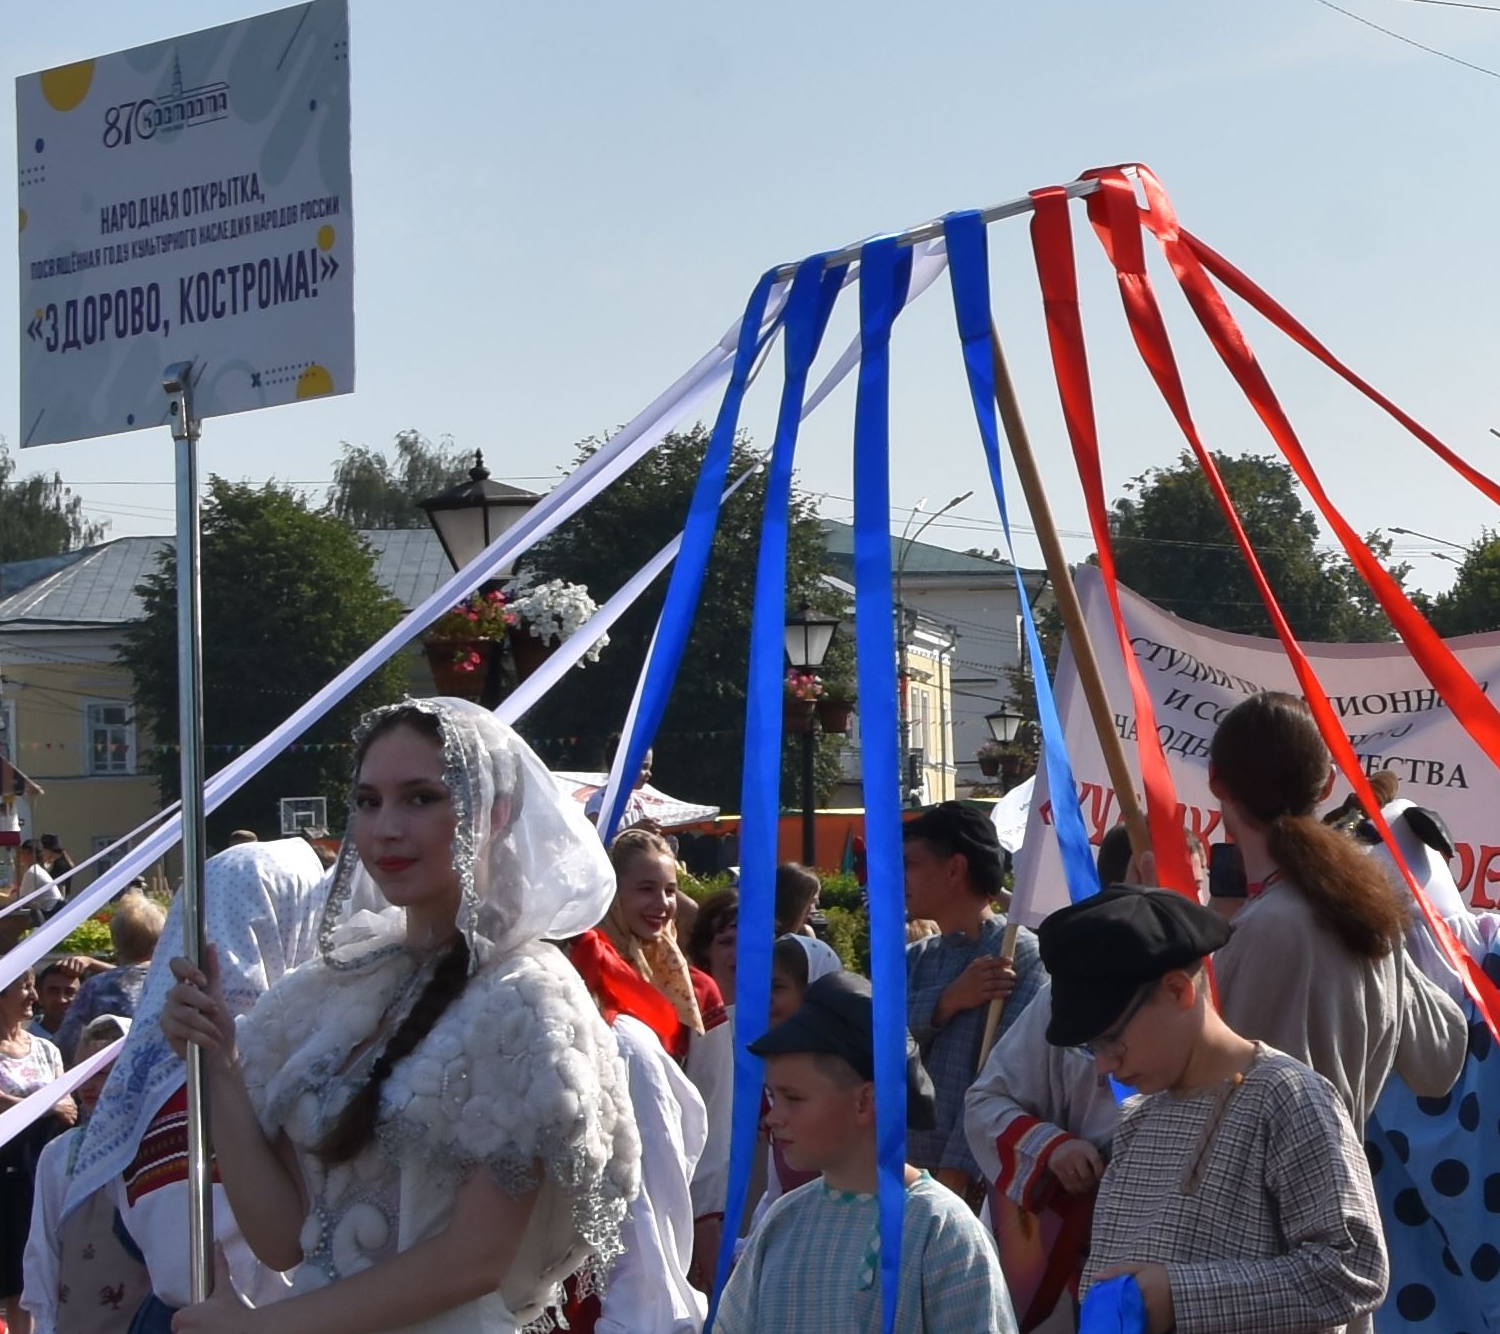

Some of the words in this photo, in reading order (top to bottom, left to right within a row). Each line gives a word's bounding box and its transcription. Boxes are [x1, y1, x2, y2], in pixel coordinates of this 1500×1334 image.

[100, 190, 180, 235] НАРОДНАЯ
[182, 172, 265, 218] ОТКРЫТКА,
[30, 248, 101, 281] ПОСВЯЩЁННАЯ
[103, 242, 130, 266] ГОДУ
[131, 227, 197, 260] КУЛЬТУРНОГО
[199, 215, 251, 245] НАСЛЕДИЯ
[253, 204, 298, 234] НАРОДОВ
[300, 195, 340, 222] РОССИИ
[26, 281, 170, 354] «ЗДОРОВО,
[179, 247, 340, 325] КОСТРОМА!»
[1129, 636, 1235, 691] СТУДИЯ
[1162, 687, 1194, 712] И
